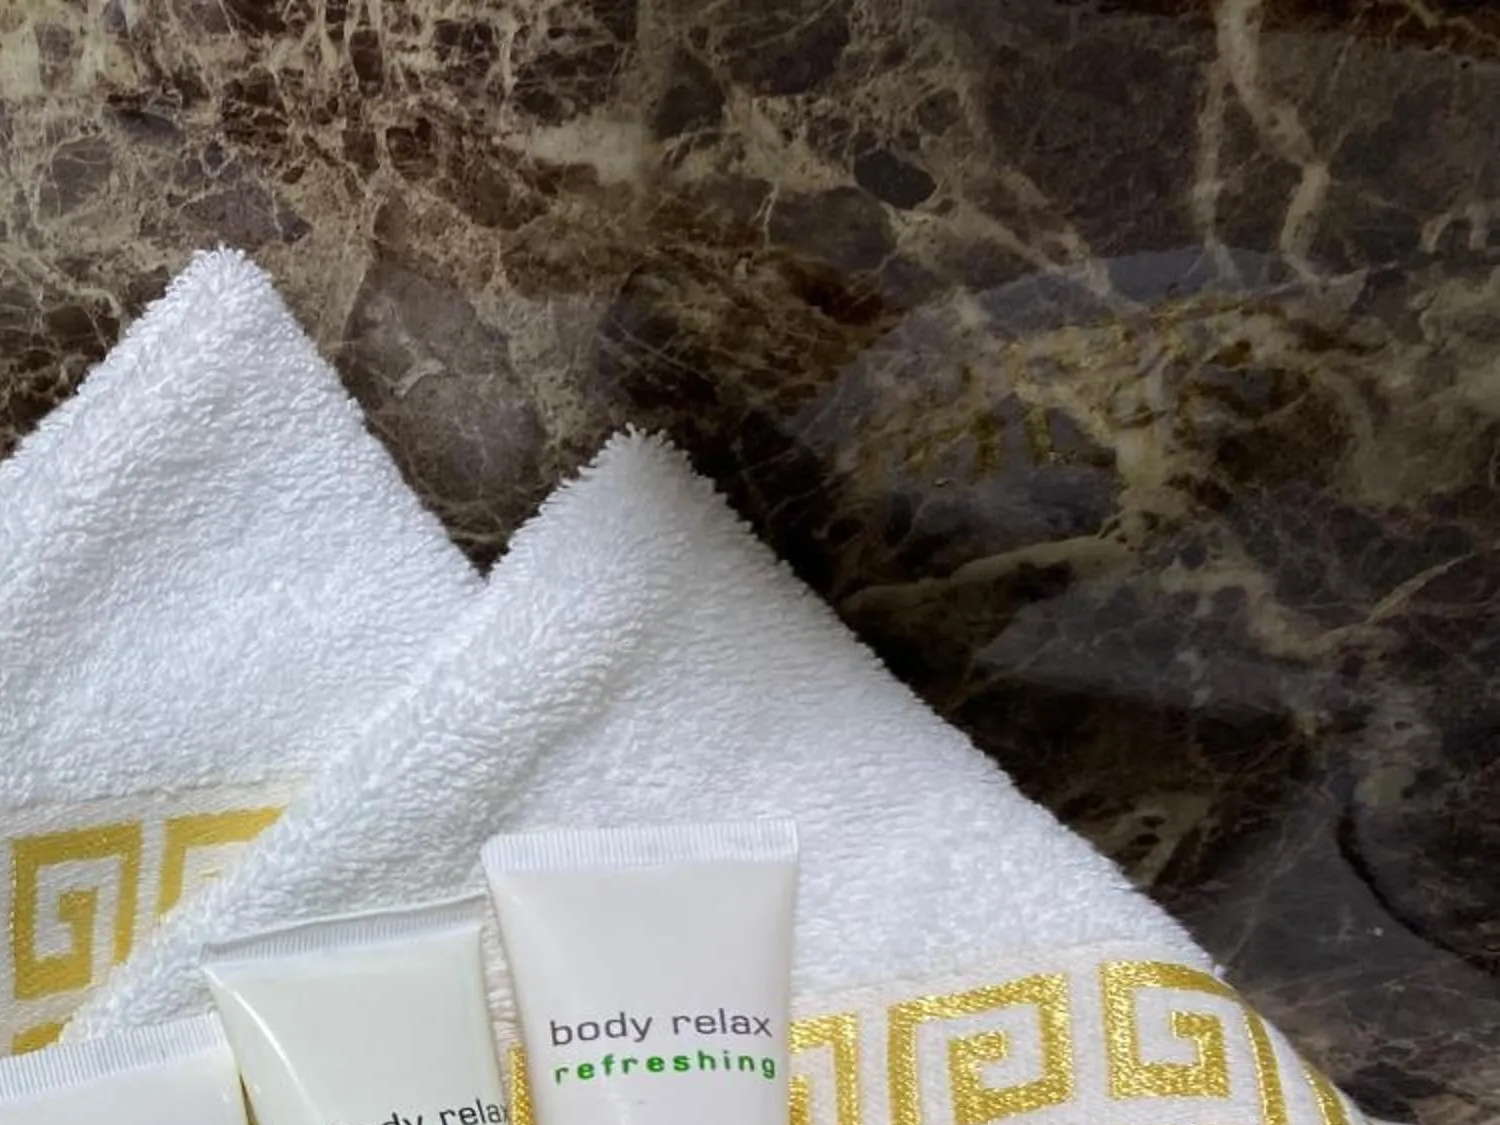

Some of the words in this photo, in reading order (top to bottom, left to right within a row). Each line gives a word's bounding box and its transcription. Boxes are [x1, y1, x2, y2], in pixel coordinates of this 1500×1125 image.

[550, 1011, 653, 1046] body
[671, 1007, 774, 1037] relax
[554, 1049, 777, 1084] refreshing
